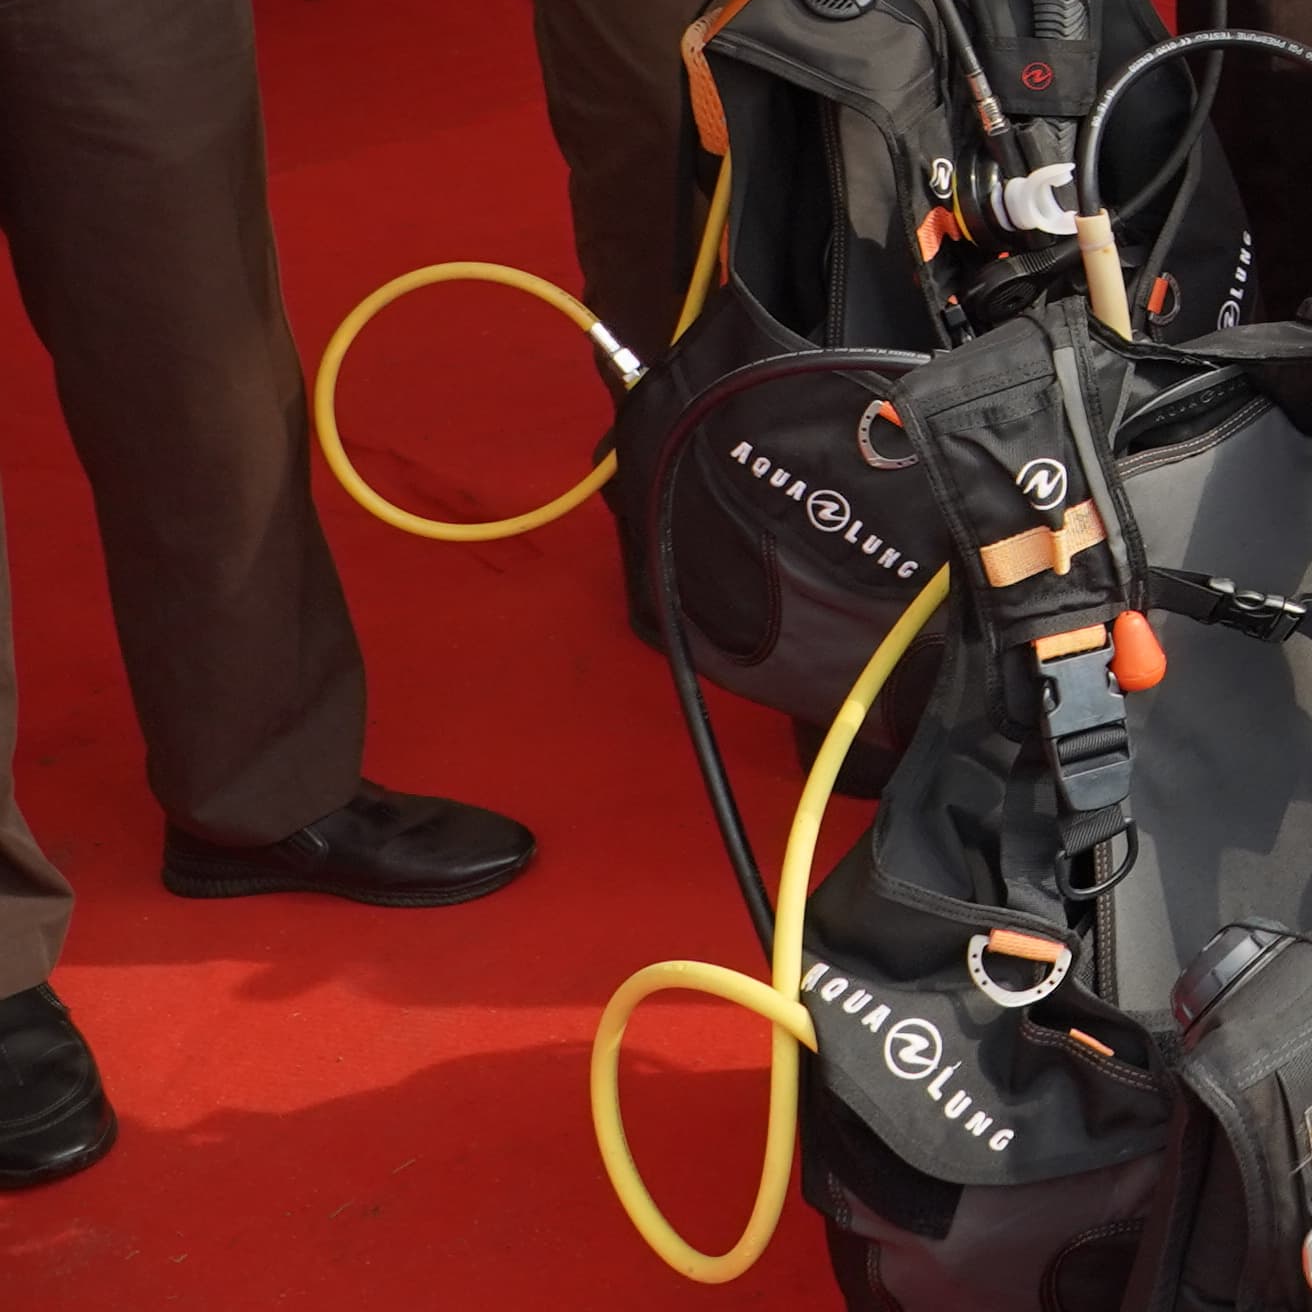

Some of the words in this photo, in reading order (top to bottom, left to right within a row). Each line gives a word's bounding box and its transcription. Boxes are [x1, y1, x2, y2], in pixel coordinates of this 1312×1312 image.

[730, 441, 807, 501] AQUA
[844, 520, 919, 578] LUNG
[801, 962, 892, 1033] AQUA
[927, 1065, 1016, 1151] LUNG
